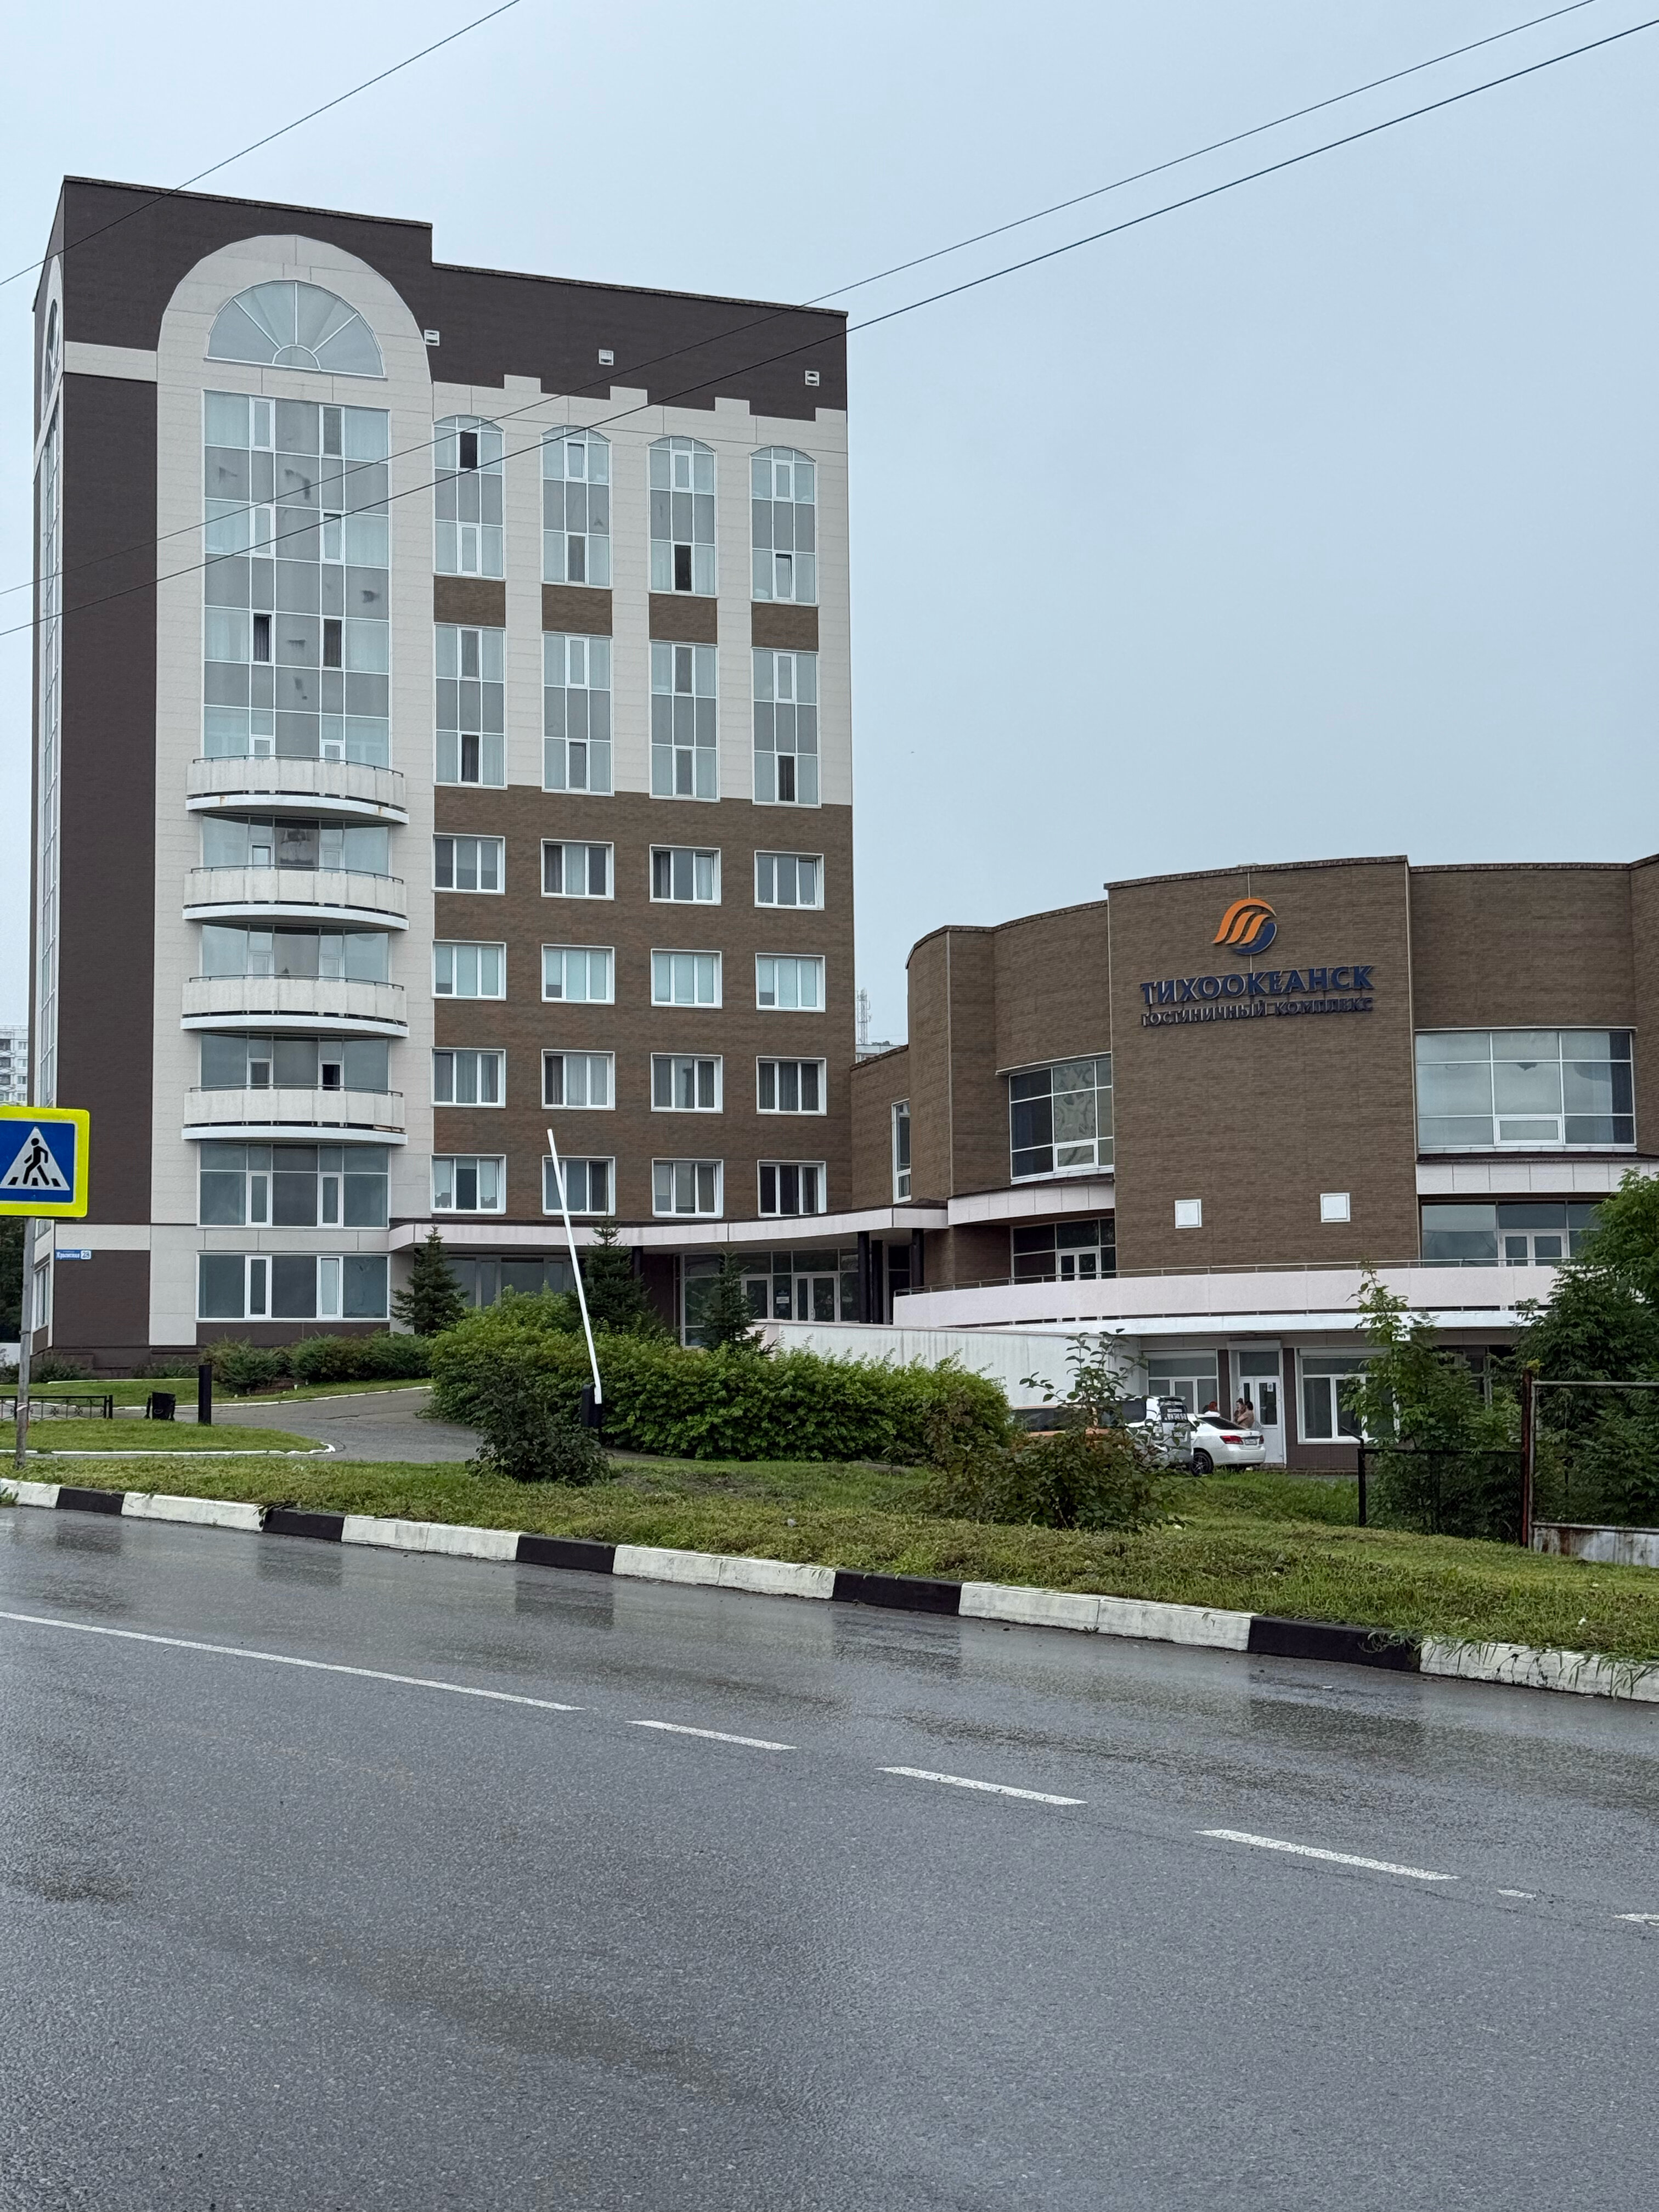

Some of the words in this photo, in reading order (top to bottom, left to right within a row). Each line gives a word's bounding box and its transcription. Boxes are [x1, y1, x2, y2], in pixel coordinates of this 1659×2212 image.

[1141, 966, 1374, 1006] ТИХООКЕАНСК
[1142, 1000, 1267, 1027] ГОСТИНИЧНЫЙ
[1275, 997, 1373, 1015] КОМПЛЕКС
